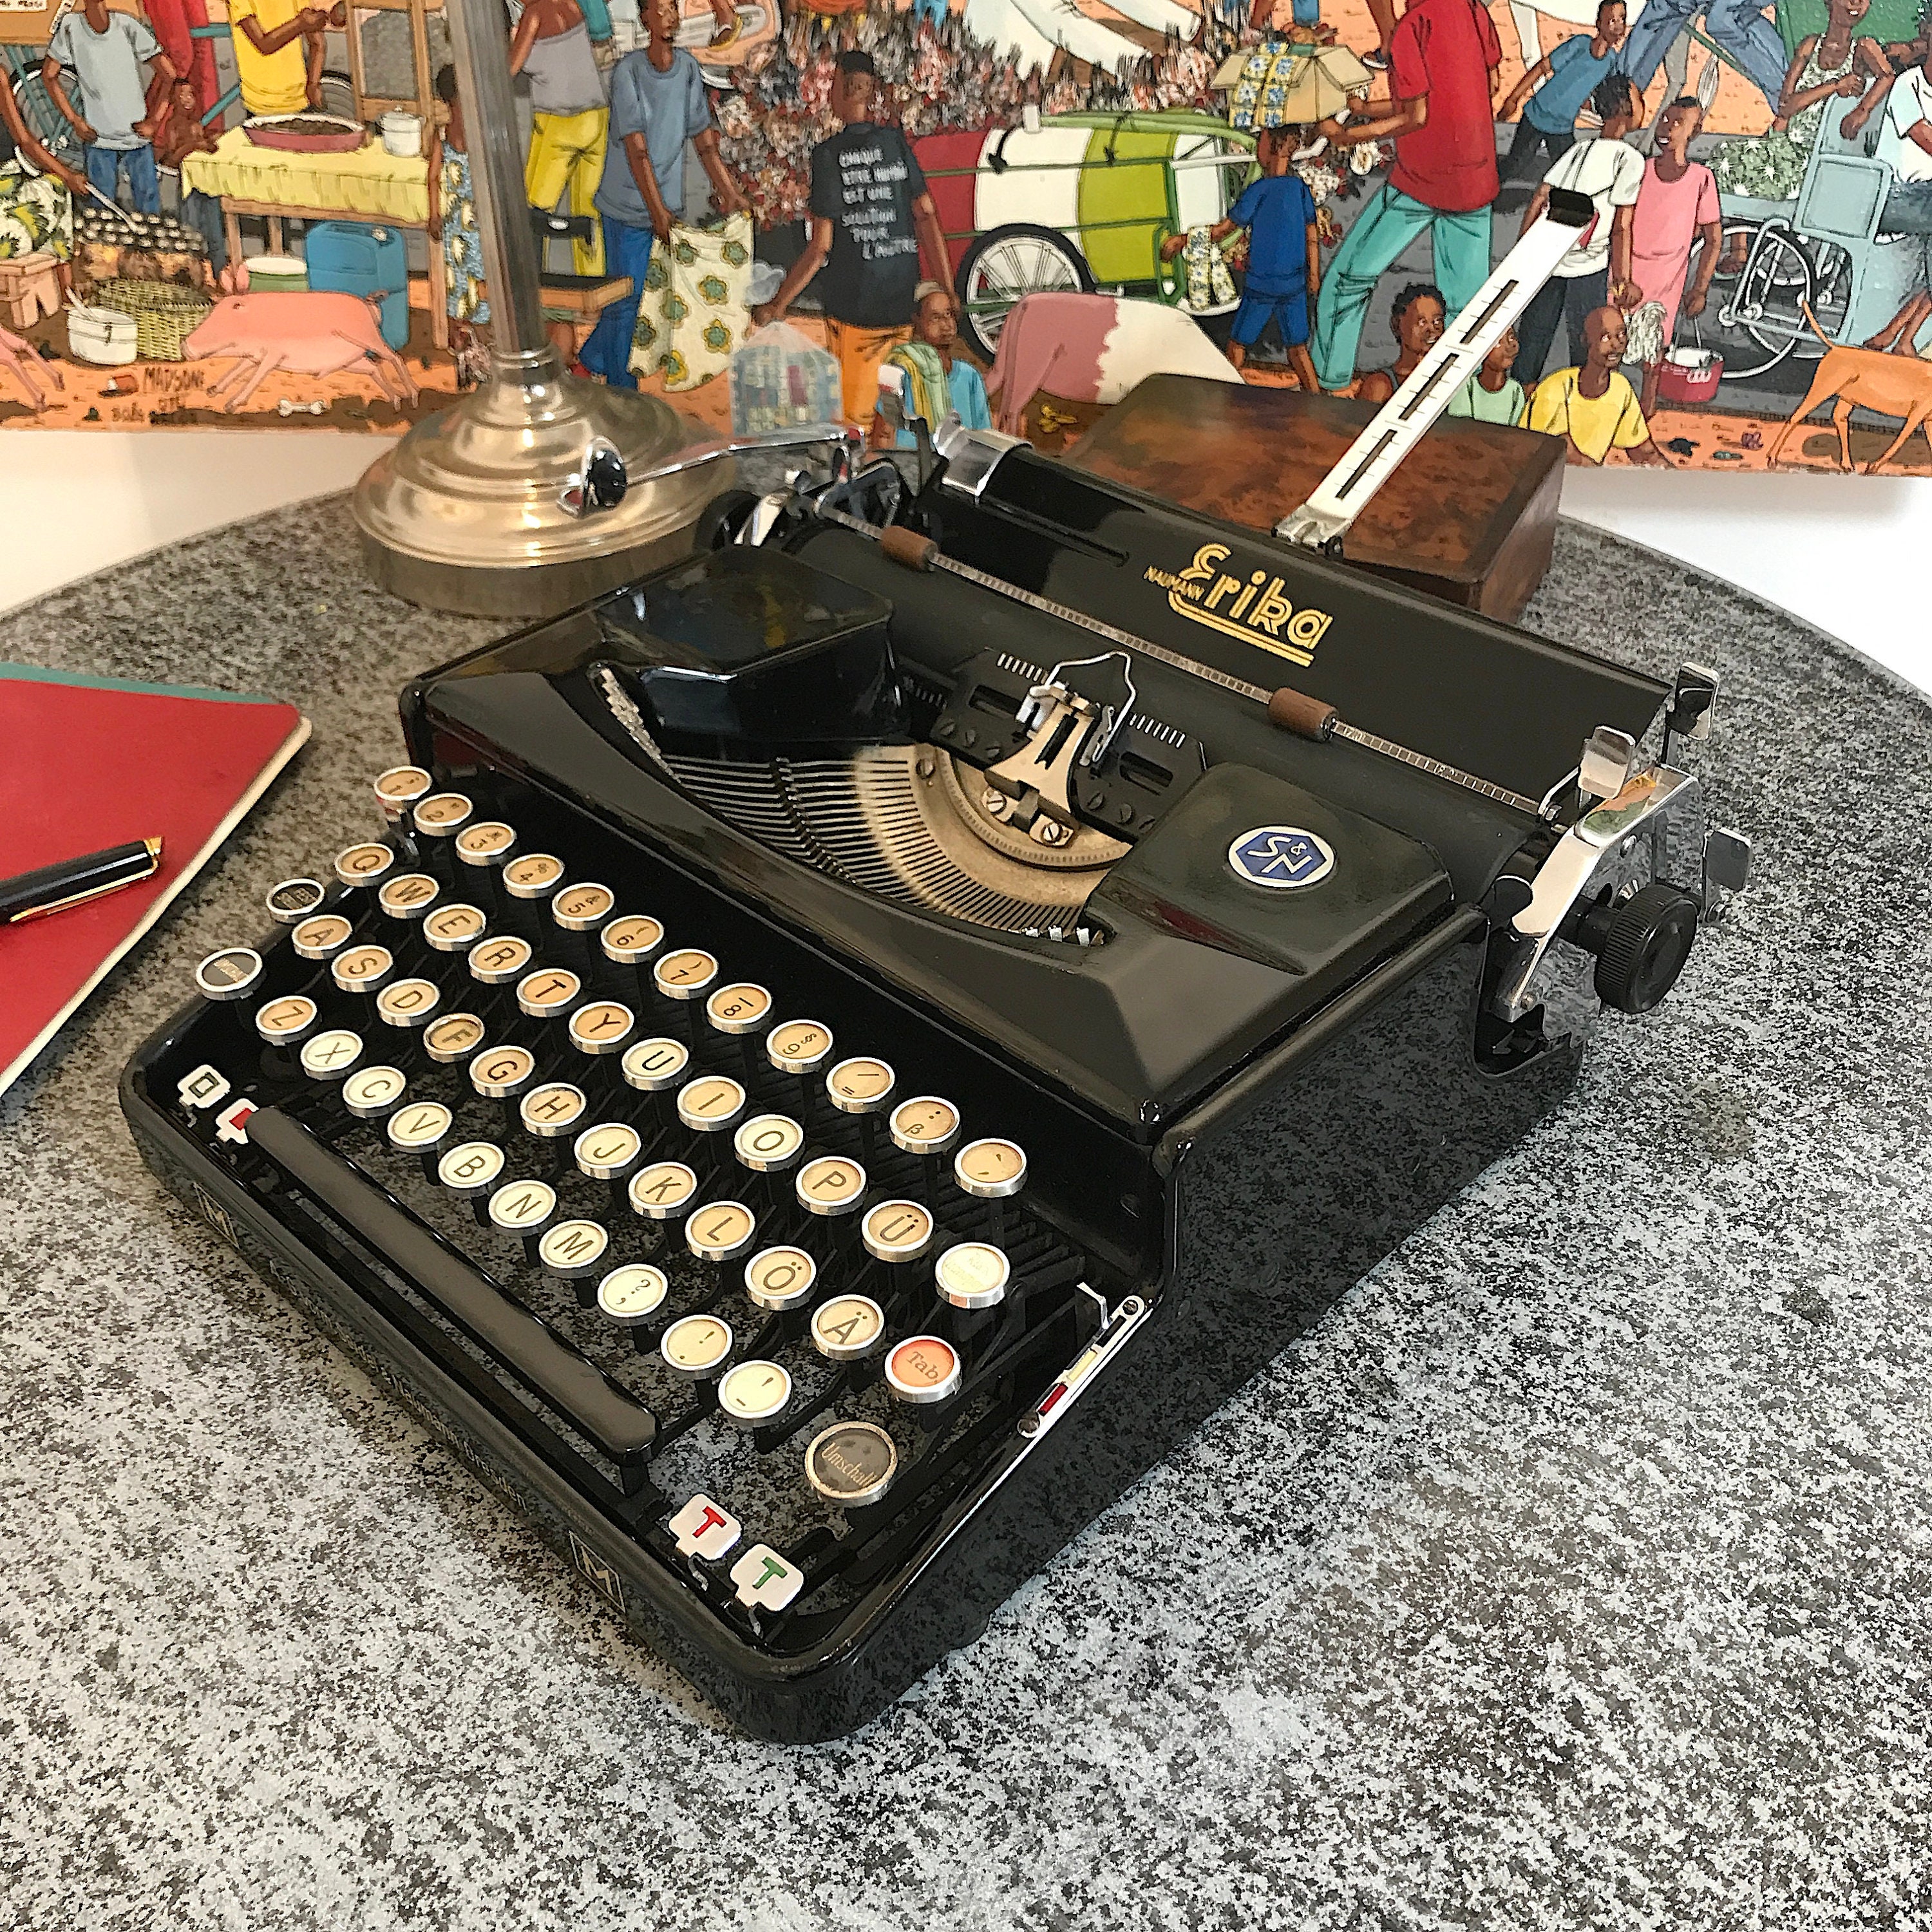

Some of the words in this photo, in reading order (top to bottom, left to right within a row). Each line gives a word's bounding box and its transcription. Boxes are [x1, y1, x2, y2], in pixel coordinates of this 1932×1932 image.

[1143, 565, 1205, 601] NAUMANN
[1179, 542, 1334, 650] Erika
[352, 854, 380, 871] Q
[395, 882, 431, 902] W
[568, 902, 586, 914] 5
[438, 915, 471, 934] E
[304, 928, 334, 947] A
[616, 934, 634, 946] 6
[348, 957, 378, 975] S
[484, 947, 516, 967] R
[535, 979, 567, 998] T
[392, 990, 423, 1009] D
[723, 1004, 741, 1016] 8
[272, 1006, 304, 1027] Z
[589, 1012, 621, 1032] Y
[442, 1028, 473, 1043] F
[314, 1042, 351, 1065] X
[782, 1043, 800, 1055] 9
[487, 1060, 518, 1081] G
[642, 1050, 675, 1071] U
[362, 1080, 392, 1098] C
[534, 1095, 571, 1120] H
[697, 1093, 725, 1110] I
[408, 1112, 440, 1134] V
[592, 1142, 626, 1159] J
[753, 1130, 785, 1151] O
[453, 1155, 486, 1178] B
[645, 1176, 681, 1202] K
[812, 1171, 847, 1190] P
[505, 1193, 542, 1218] N
[706, 1216, 733, 1242] L
[880, 1214, 919, 1242] Ü
[553, 1231, 594, 1260] M
[762, 1262, 802, 1291] Ö
[823, 1311, 868, 1345] Ä
[692, 1505, 727, 1539] T
[752, 1556, 788, 1590] T
